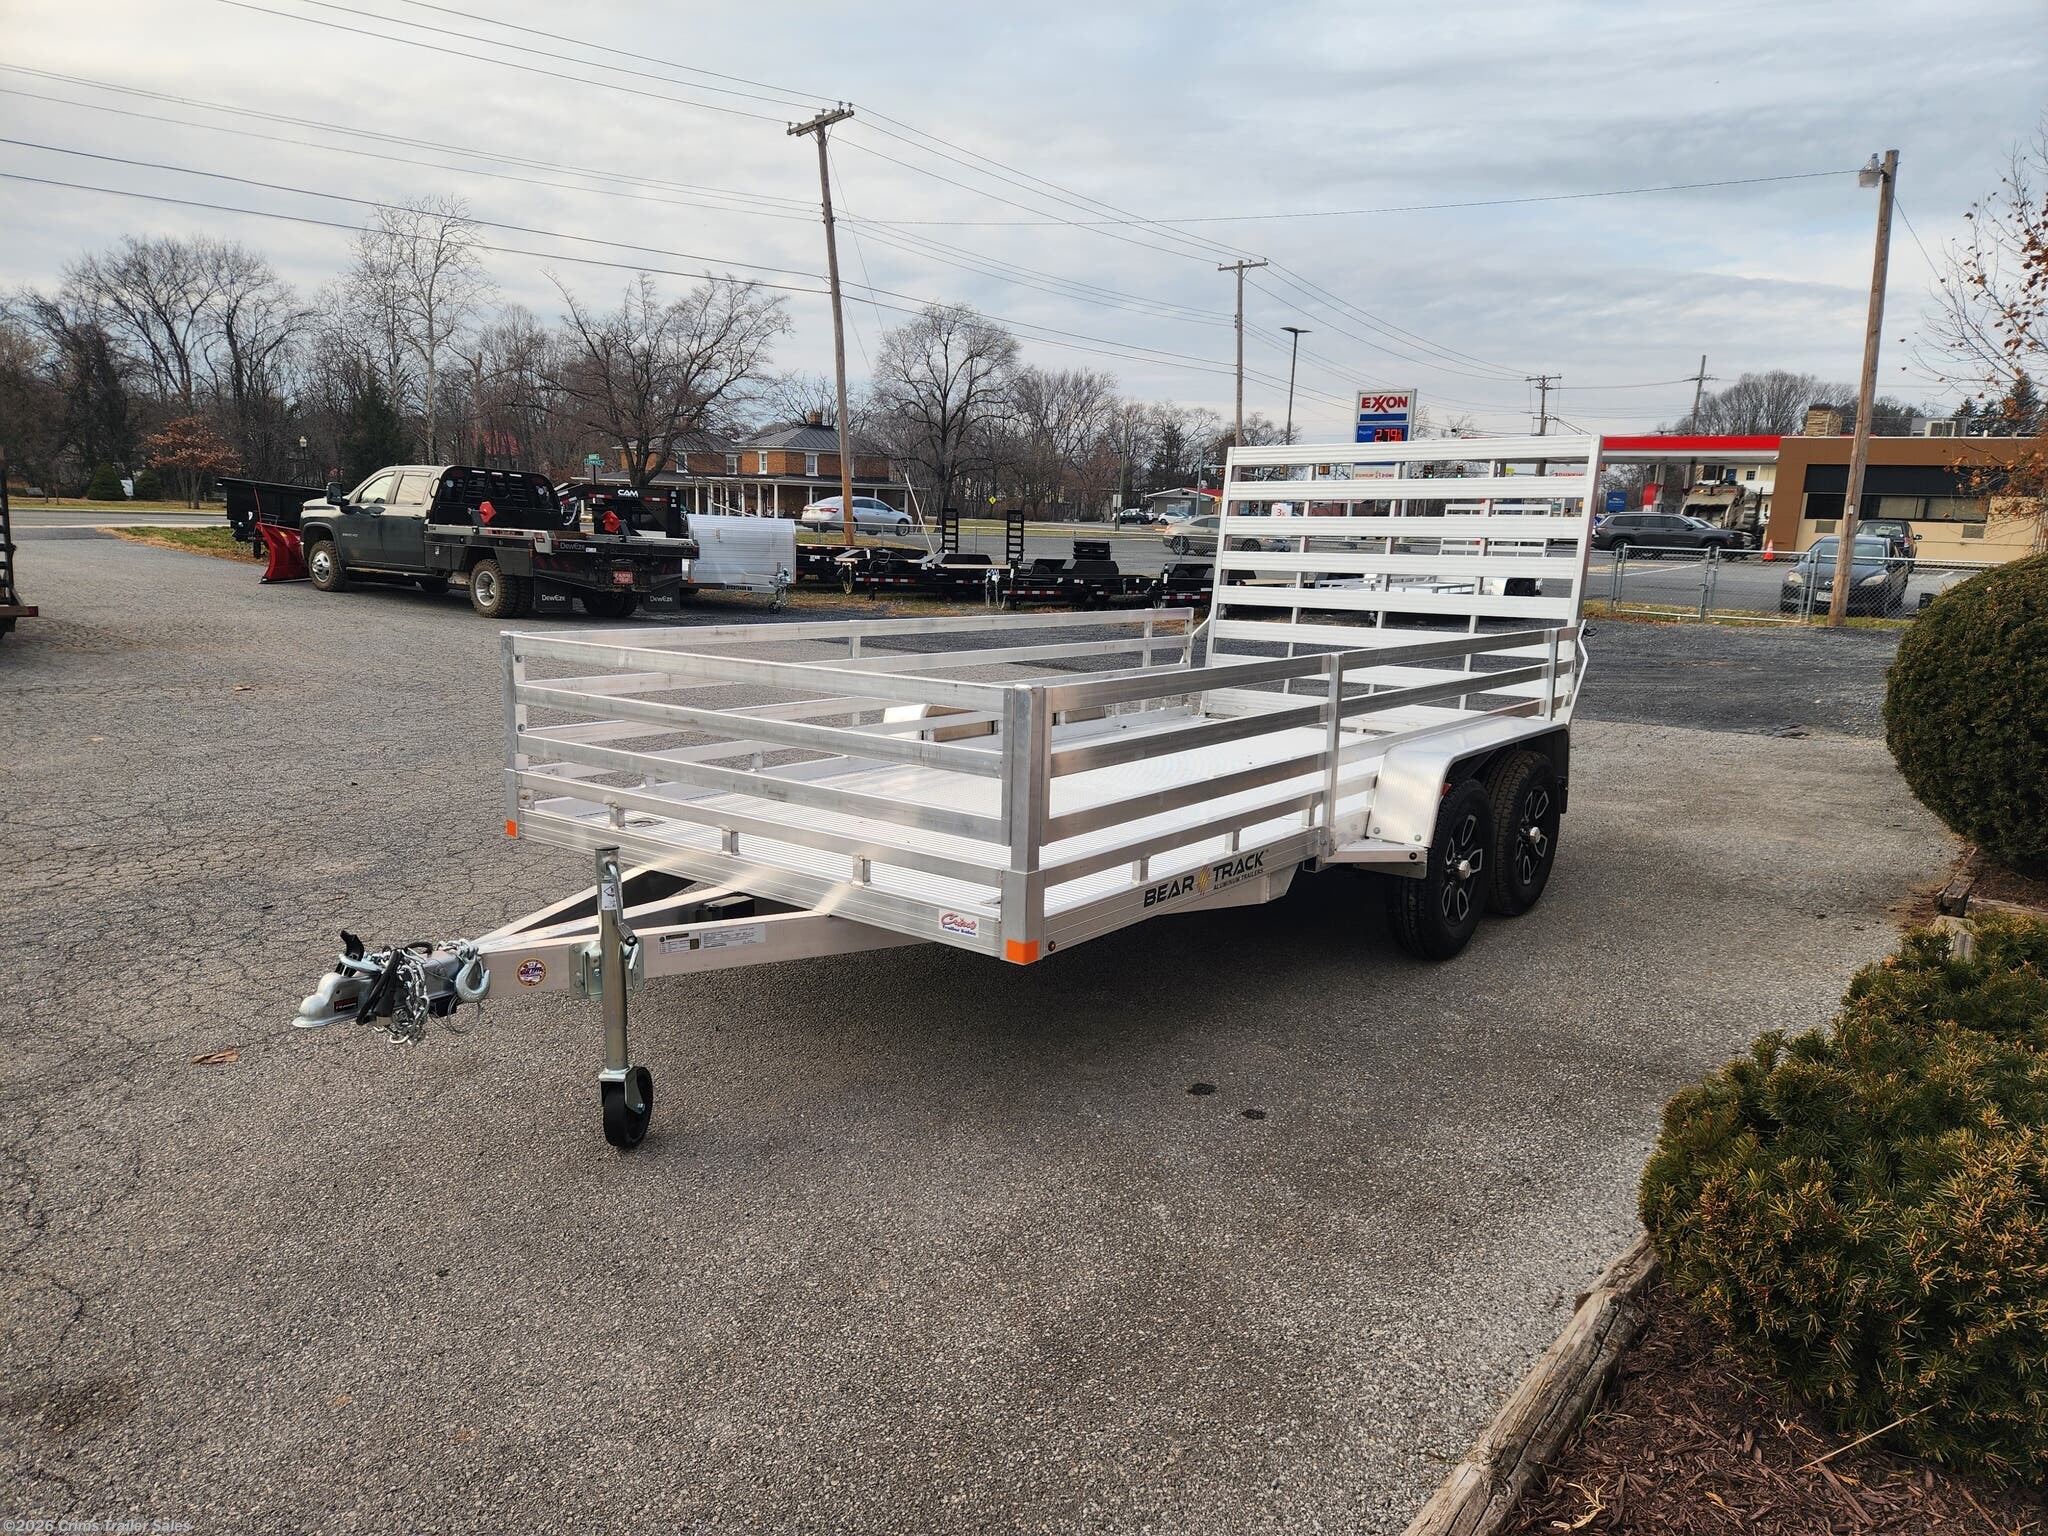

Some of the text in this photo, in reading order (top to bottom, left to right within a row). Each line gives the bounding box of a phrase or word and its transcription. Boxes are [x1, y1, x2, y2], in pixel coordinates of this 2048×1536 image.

[1361, 394, 1408, 413] EXXON
[617, 489, 639, 498] CAM
[541, 594, 566, 602] DewEze
[650, 595, 673, 603] DewEze
[1143, 851, 1264, 908] BEAR TRACK
